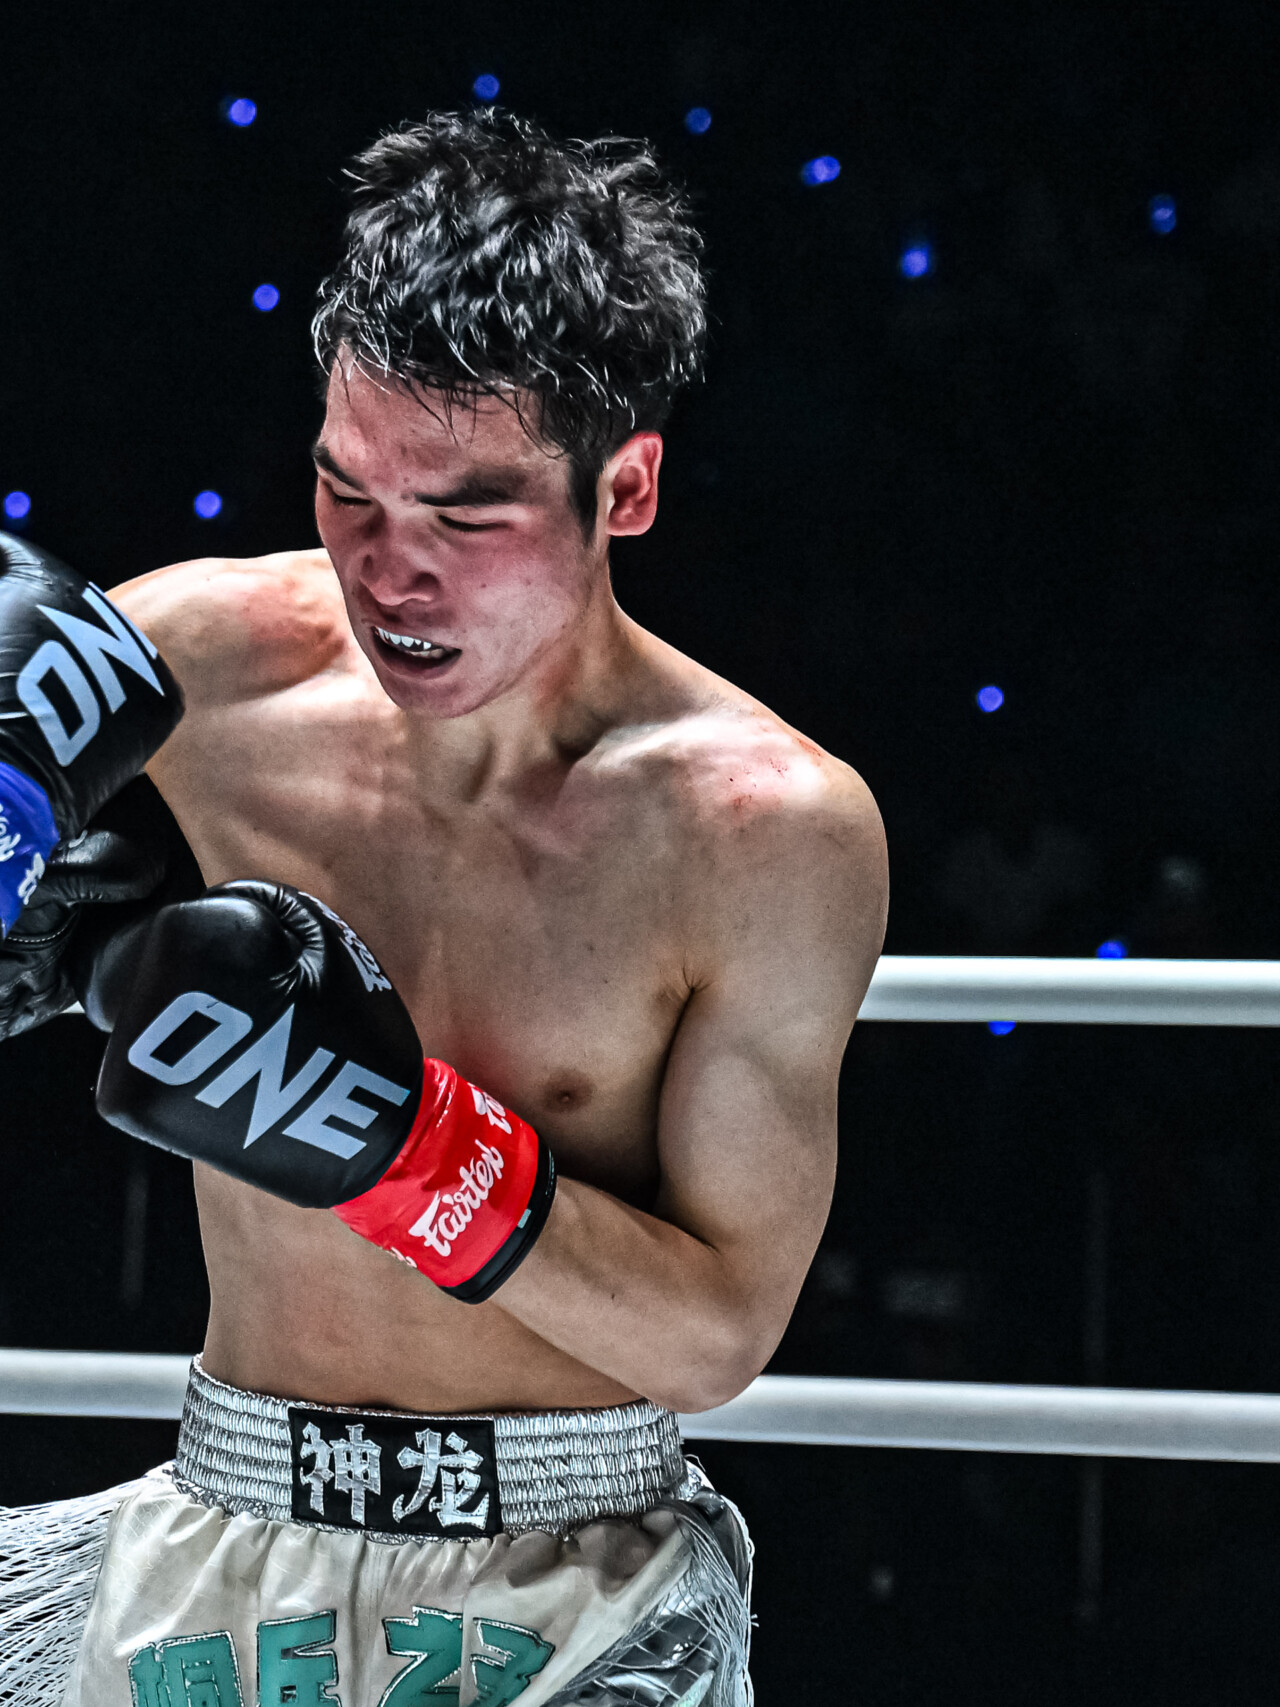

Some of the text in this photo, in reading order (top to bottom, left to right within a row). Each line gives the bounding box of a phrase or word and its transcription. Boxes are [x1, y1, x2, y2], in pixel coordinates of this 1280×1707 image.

[17, 581, 164, 767] ON
[128, 991, 412, 1161] ONE
[408, 1139, 504, 1257] Fairtex
[297, 1420, 489, 1532] 神龙
